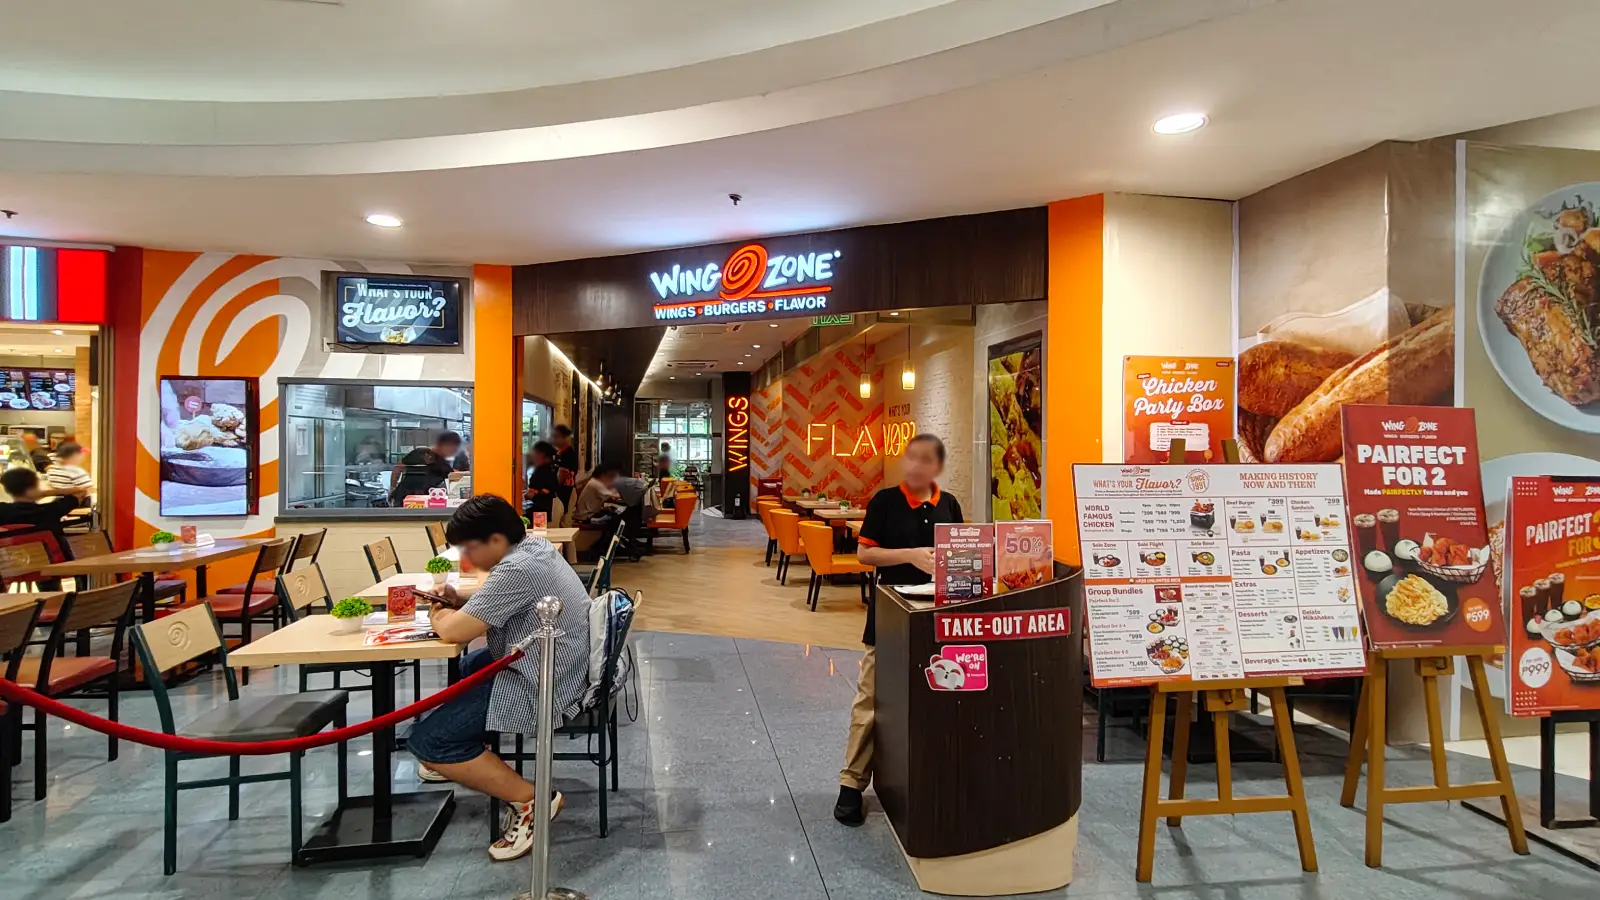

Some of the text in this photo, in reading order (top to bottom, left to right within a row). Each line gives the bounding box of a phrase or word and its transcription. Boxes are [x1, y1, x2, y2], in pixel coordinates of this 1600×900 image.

[650, 252, 833, 299] WING ZONE
[342, 297, 446, 328] Flavor?
[655, 296, 826, 319] WINGS BURGERS FLAVOR
[1141, 377, 1217, 397] Chicken
[1133, 393, 1225, 420] Party Box
[728, 396, 749, 472] WINGS
[1381, 419, 1439, 432] WING ZONE
[1357, 444, 1466, 465] PAIRFECT
[1093, 478, 1182, 490] WHAT'S YOUR Flavor?
[1382, 466, 1447, 486] FOR 2
[1552, 486, 1600, 496] WING ZON
[1526, 512, 1593, 546] PAIRFECT
[1568, 535, 1593, 557] FOR
[1088, 588, 1111, 596] Group
[941, 613, 1065, 637] TAKE-OUT AREA
